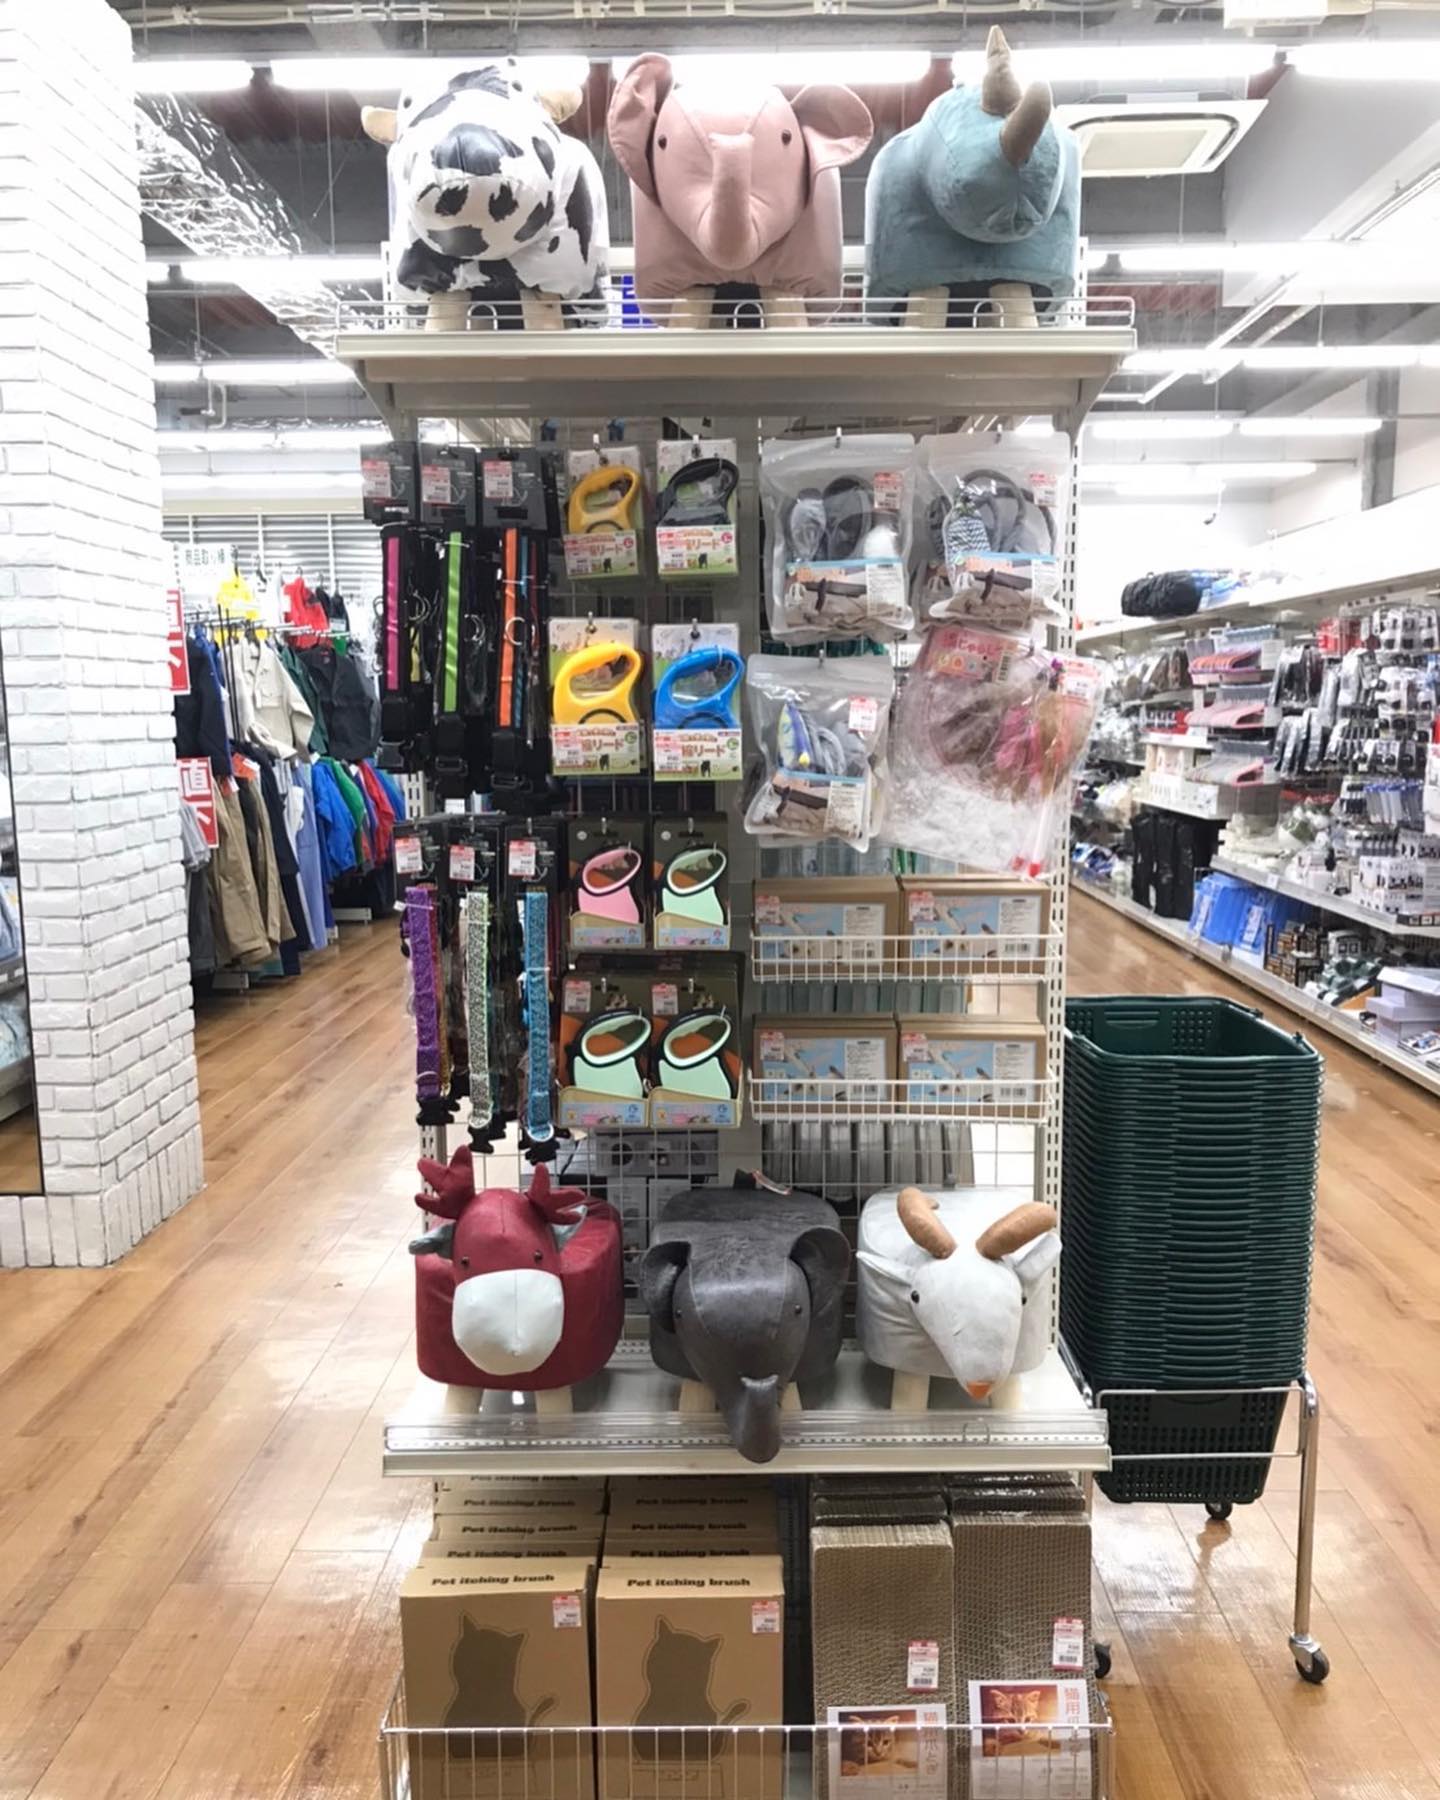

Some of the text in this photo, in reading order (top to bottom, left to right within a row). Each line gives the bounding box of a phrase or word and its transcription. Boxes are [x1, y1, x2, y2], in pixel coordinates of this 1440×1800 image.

[431, 1574, 555, 1586] Pet itching brush
[627, 1577, 751, 1587] Pet itching brush
